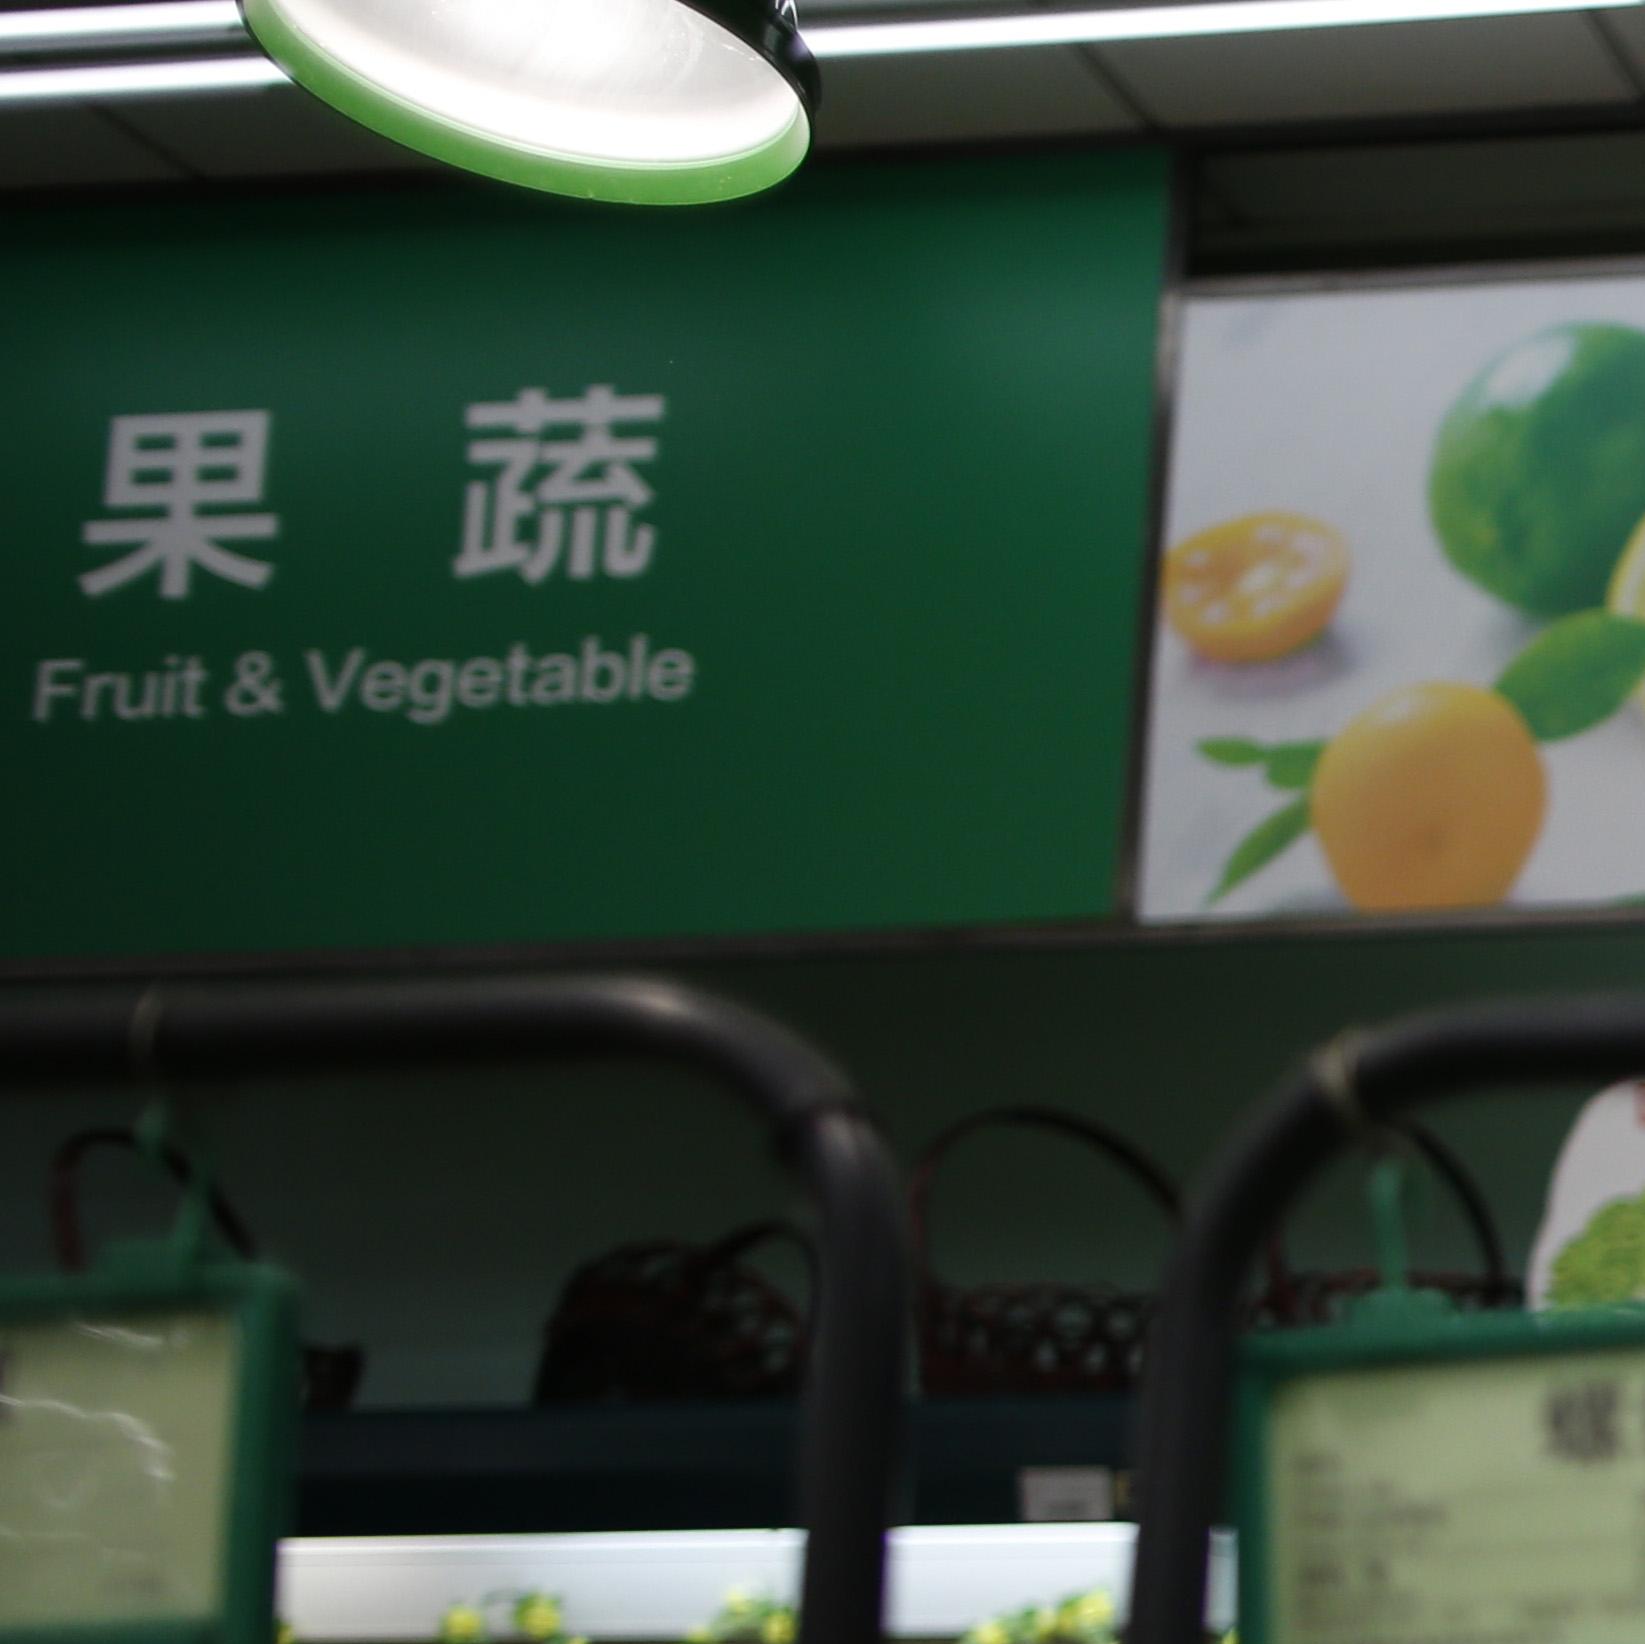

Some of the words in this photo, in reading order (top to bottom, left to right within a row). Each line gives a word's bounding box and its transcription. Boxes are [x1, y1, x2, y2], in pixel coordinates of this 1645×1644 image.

[32, 655, 208, 723] Fruit
[225, 651, 284, 718] &
[304, 634, 696, 725] Vegetable
